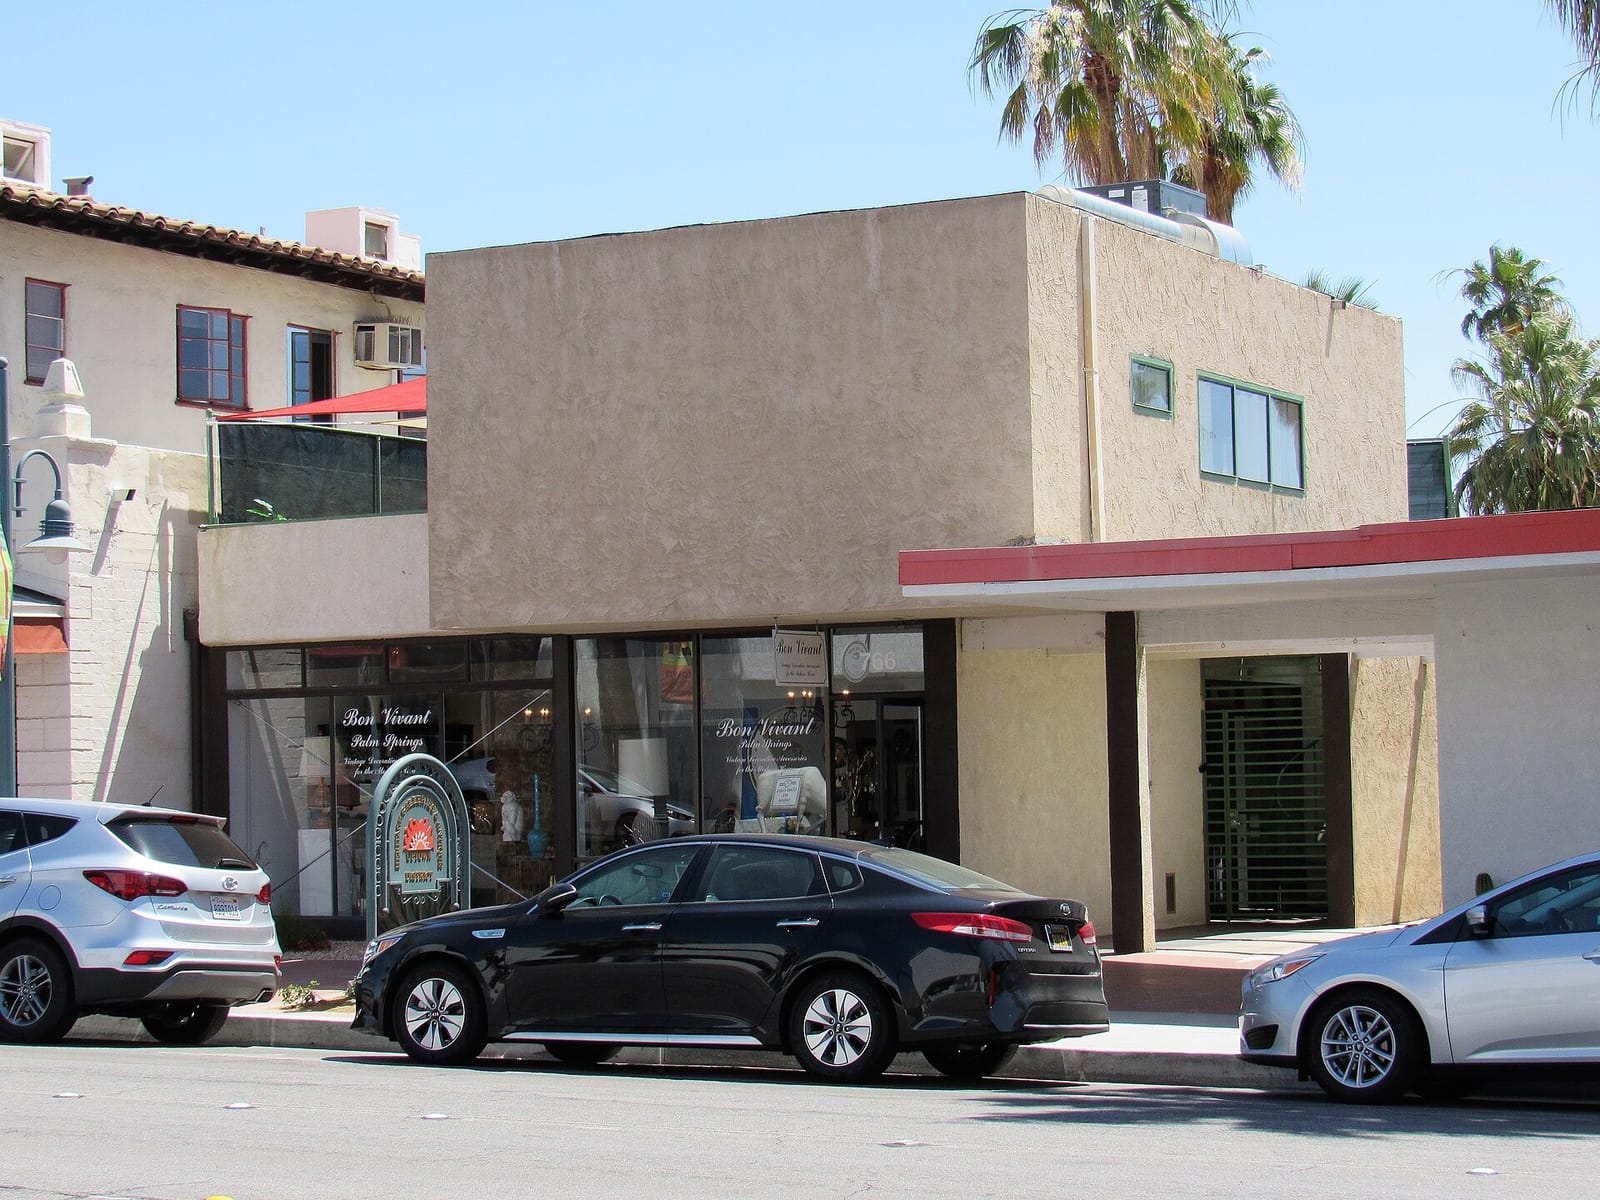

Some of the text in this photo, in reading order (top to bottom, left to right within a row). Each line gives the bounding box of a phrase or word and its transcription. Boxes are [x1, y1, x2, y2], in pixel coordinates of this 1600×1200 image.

[776, 639, 822, 656] Bon Vivant
[859, 651, 896, 671] 766
[342, 706, 432, 727] Bon Vivant
[715, 716, 815, 738] Bon Vivant
[350, 733, 424, 752] Palm Springs
[738, 738, 792, 751] Palm Springs
[344, 757, 366, 767] Vintage
